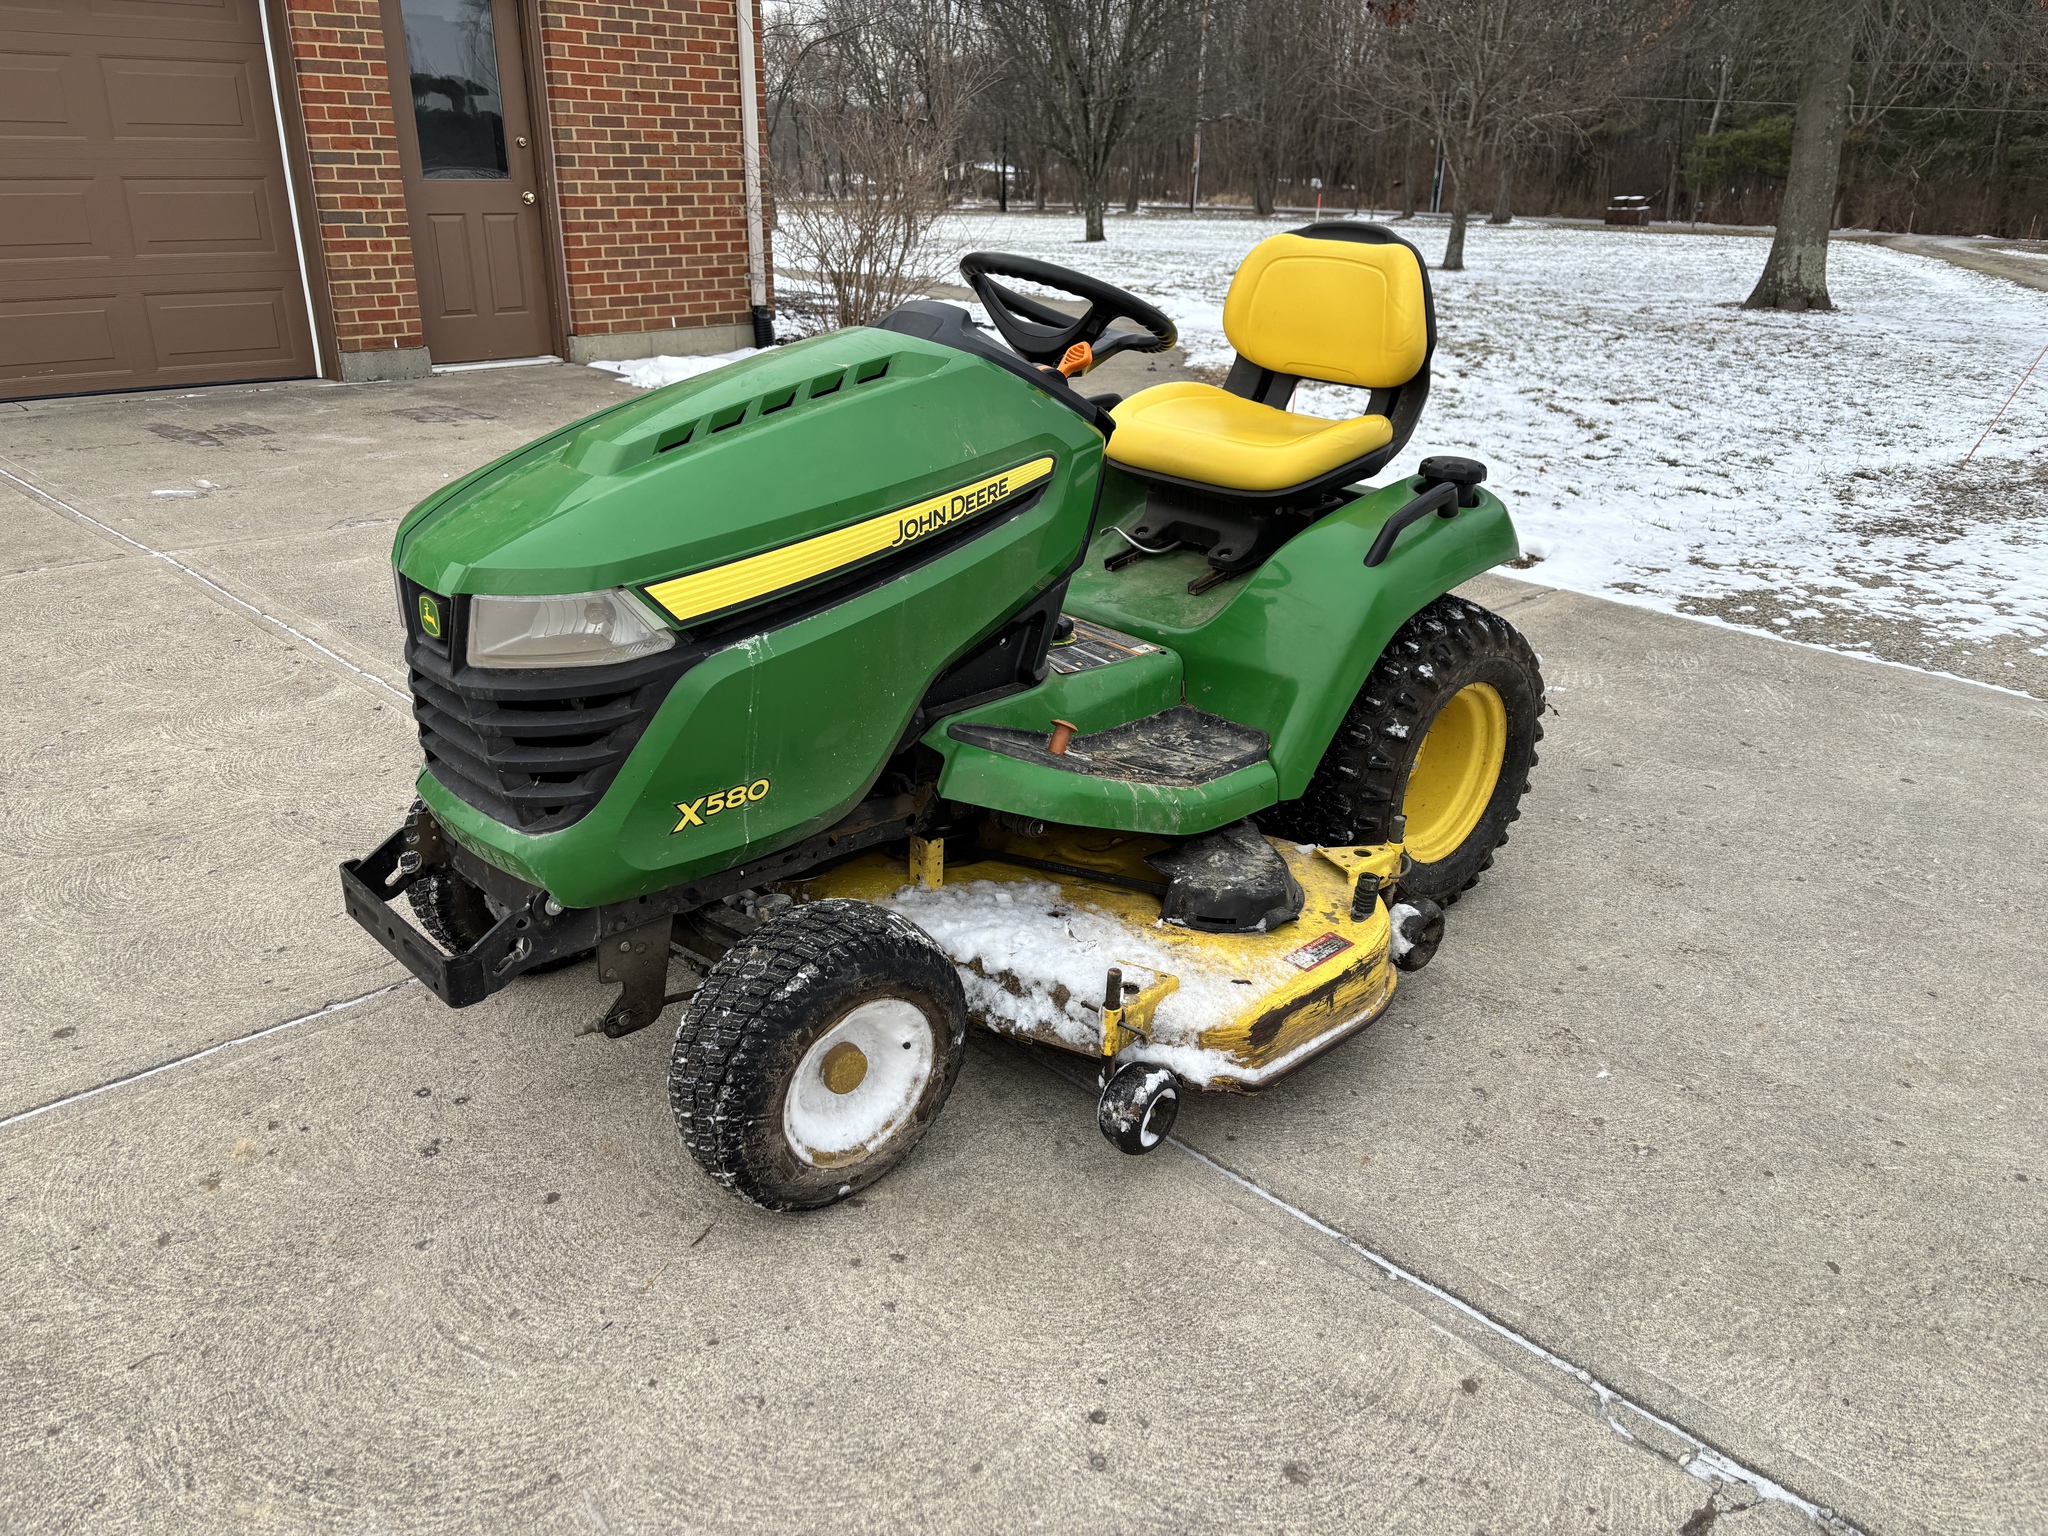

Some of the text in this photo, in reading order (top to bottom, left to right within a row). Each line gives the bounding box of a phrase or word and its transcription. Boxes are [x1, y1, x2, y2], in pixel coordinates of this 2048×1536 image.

[892, 477, 1009, 546] JOHN DEERE
[669, 778, 770, 835] X580
